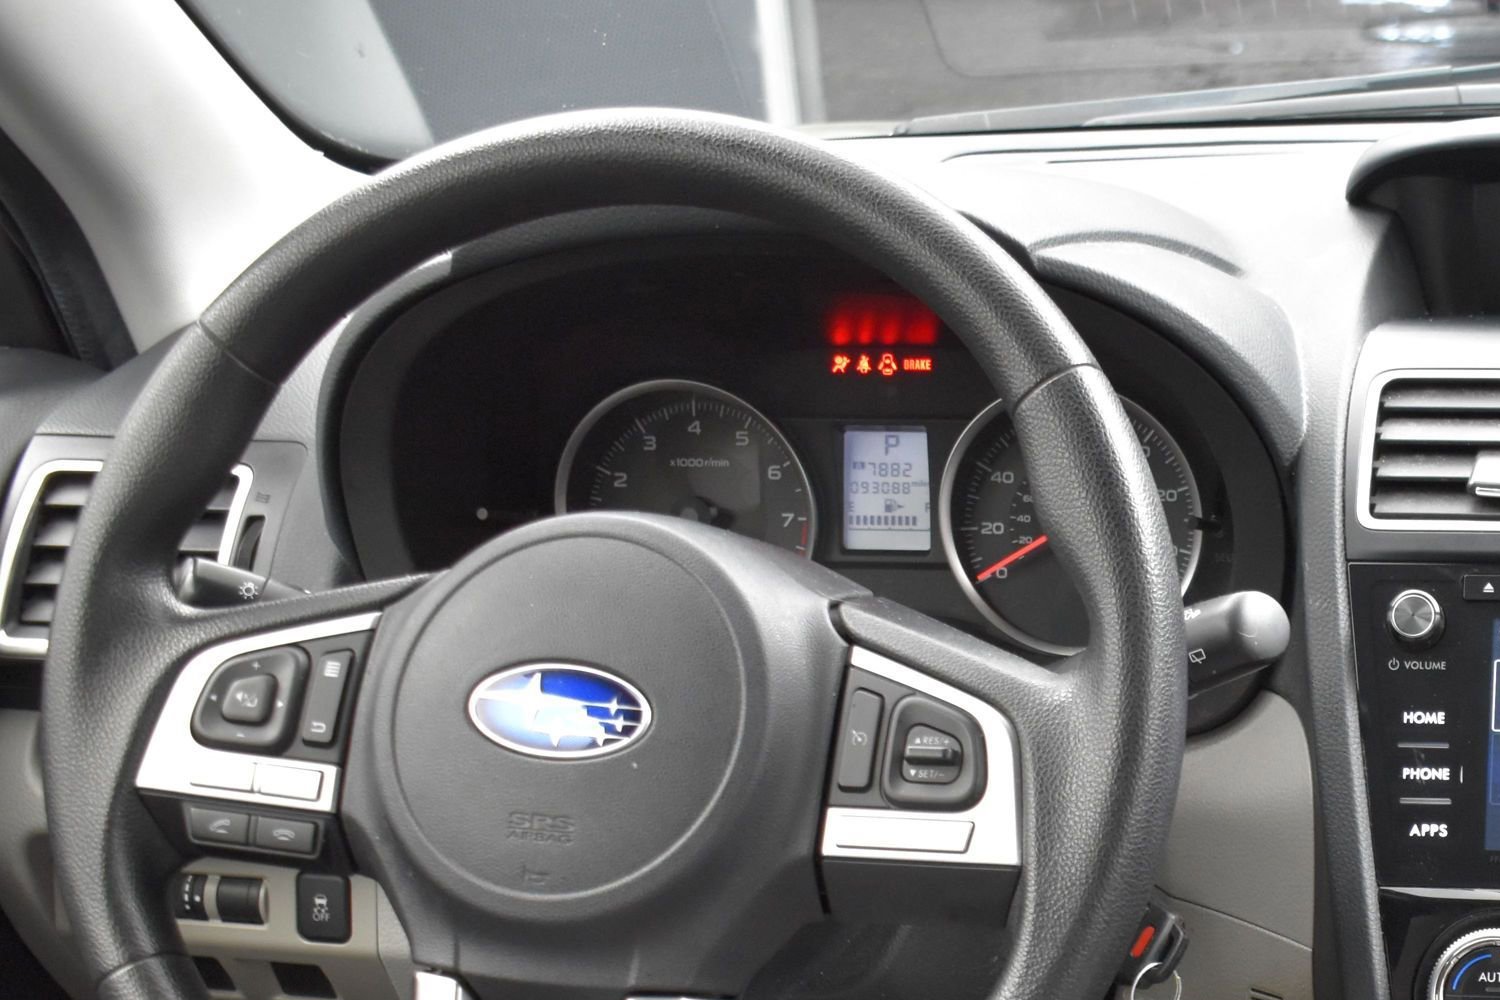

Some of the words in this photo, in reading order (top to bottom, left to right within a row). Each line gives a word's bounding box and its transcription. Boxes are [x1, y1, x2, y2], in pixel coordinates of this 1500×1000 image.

[903, 359, 932, 371] BRAKE
[688, 420, 701, 435] 4
[643, 436, 657, 451] 3
[736, 431, 749, 446] 5
[885, 434, 900, 456] P
[614, 472, 627, 487] 2
[768, 465, 782, 480] 6
[991, 471, 1014, 484] 40
[850, 481, 911, 495] 093088
[1157, 490, 1177, 502] 20
[781, 513, 794, 527] 7
[1016, 514, 1031, 523] 40
[980, 522, 1005, 535] 20
[995, 568, 1008, 579] 0
[1404, 660, 1446, 670] VOLUME
[1403, 711, 1445, 725] HOME
[1402, 767, 1450, 781] PHONE
[507, 811, 575, 832] SRS
[1409, 824, 1448, 838] APPS
[312, 912, 330, 922] OFF
